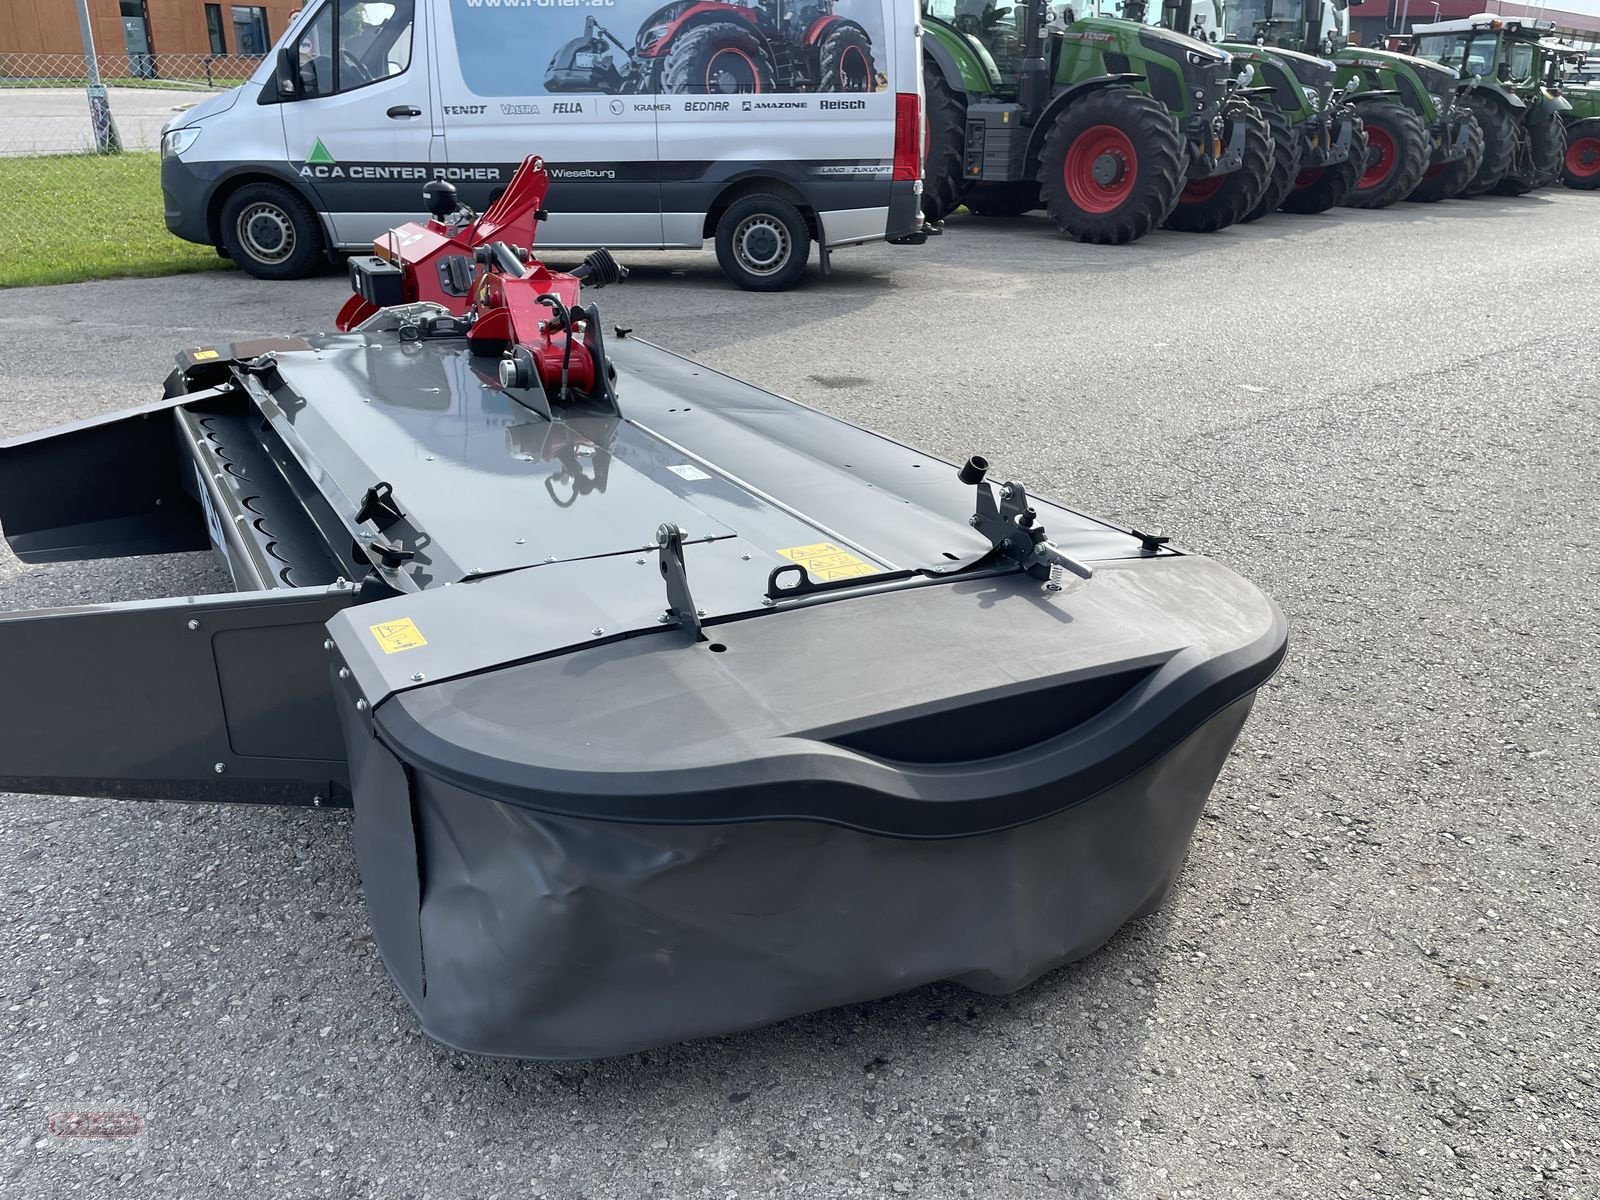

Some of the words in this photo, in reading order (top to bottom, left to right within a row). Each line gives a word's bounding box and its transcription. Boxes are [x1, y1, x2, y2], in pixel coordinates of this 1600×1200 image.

[443, 105, 488, 115] FENDT
[500, 103, 540, 115] VALTRA
[552, 102, 583, 114] FELLA
[633, 103, 672, 112] KRAMER
[684, 101, 730, 112] BEDNAR
[753, 101, 808, 109] AMAZONE
[819, 99, 866, 110] Reisch
[299, 166, 346, 178] ACA
[349, 167, 428, 179] CENTER
[433, 167, 500, 180] ROHER
[550, 168, 616, 179] Wieselburg
